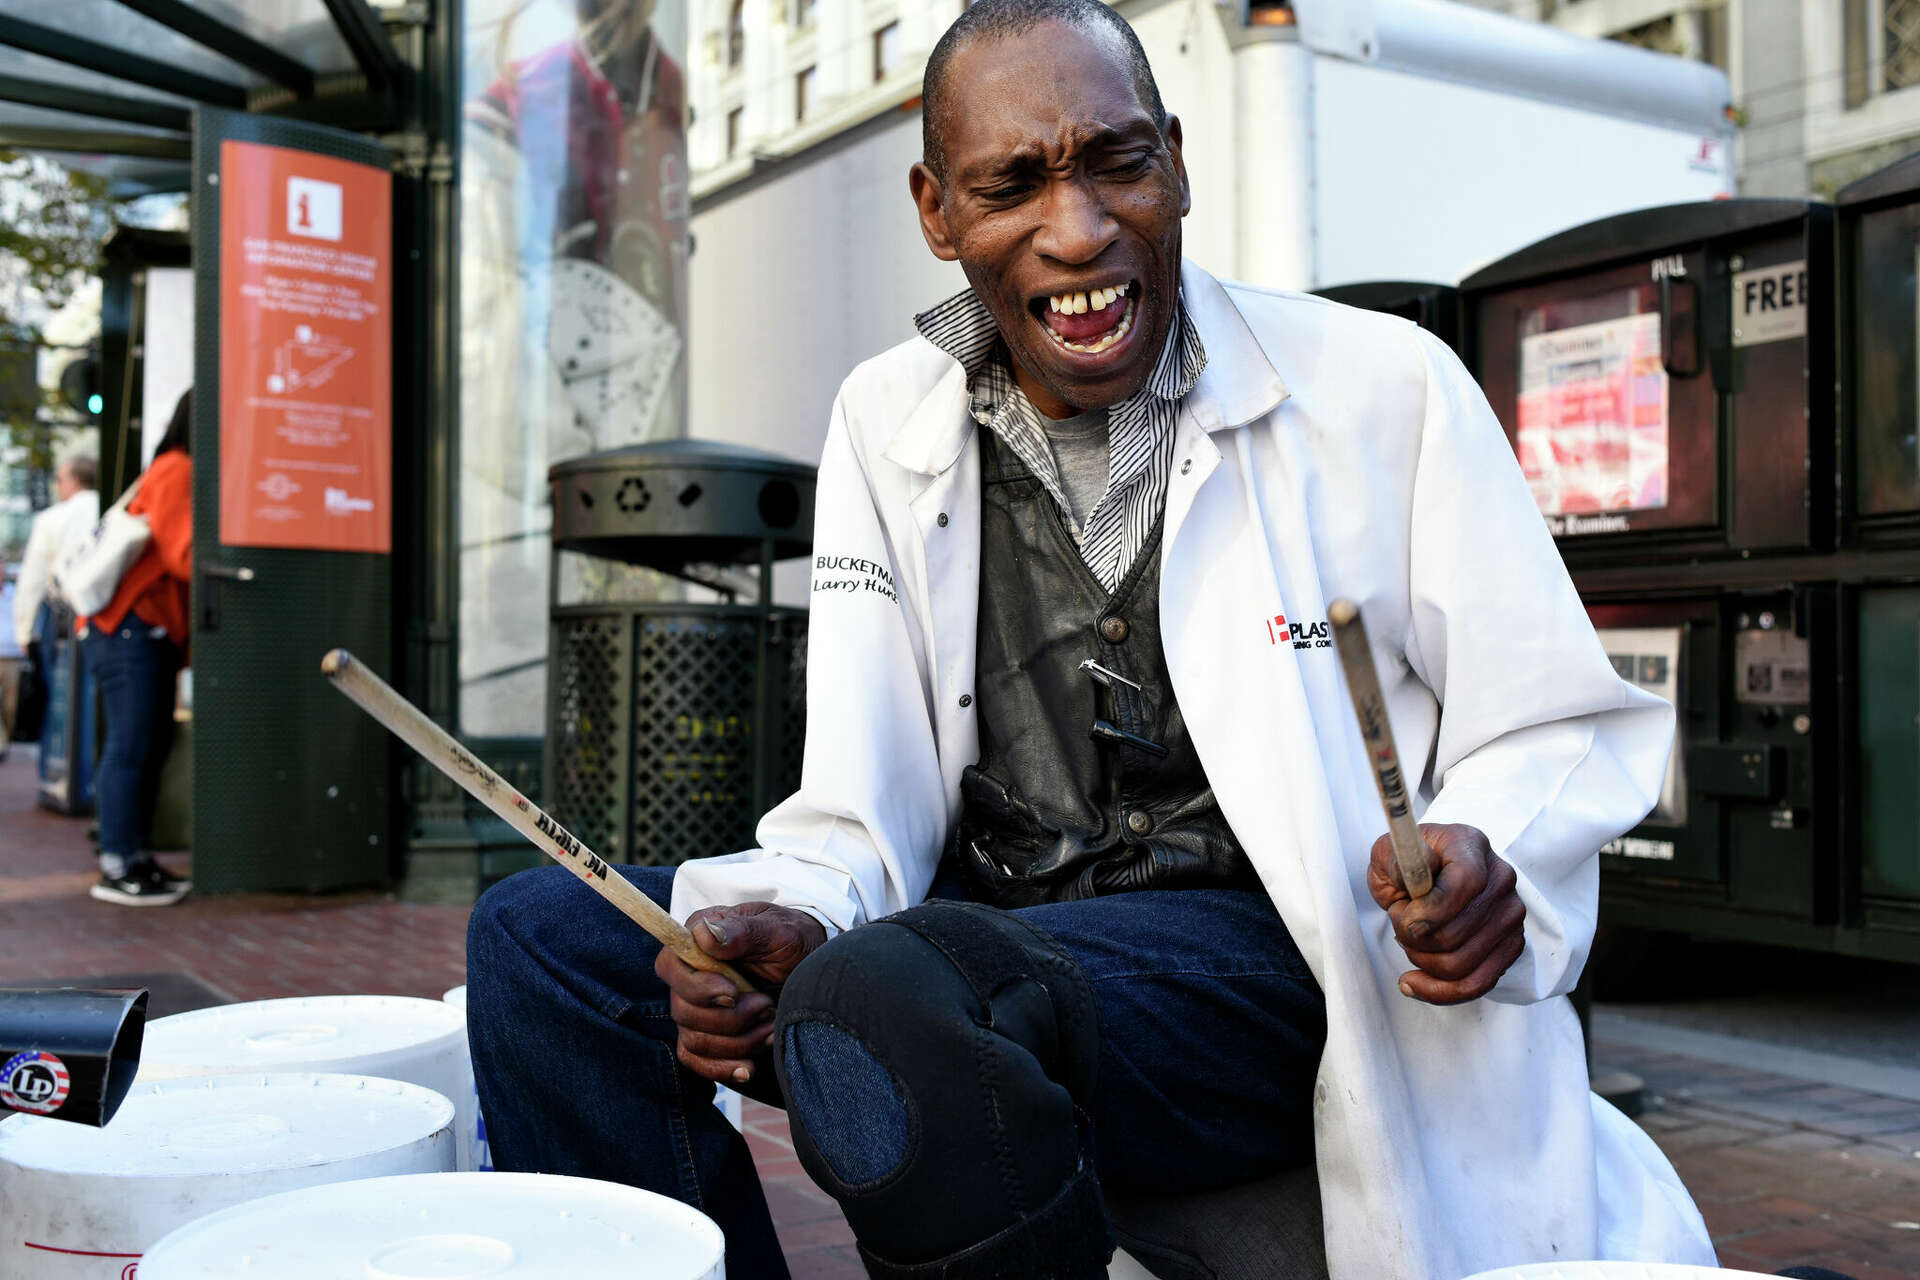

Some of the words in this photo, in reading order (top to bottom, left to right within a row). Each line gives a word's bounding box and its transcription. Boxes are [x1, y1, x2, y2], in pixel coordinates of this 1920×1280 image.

[1650, 253, 1688, 283] PULL
[813, 578, 860, 593] Larry
[15, 1069, 53, 1101] LP
